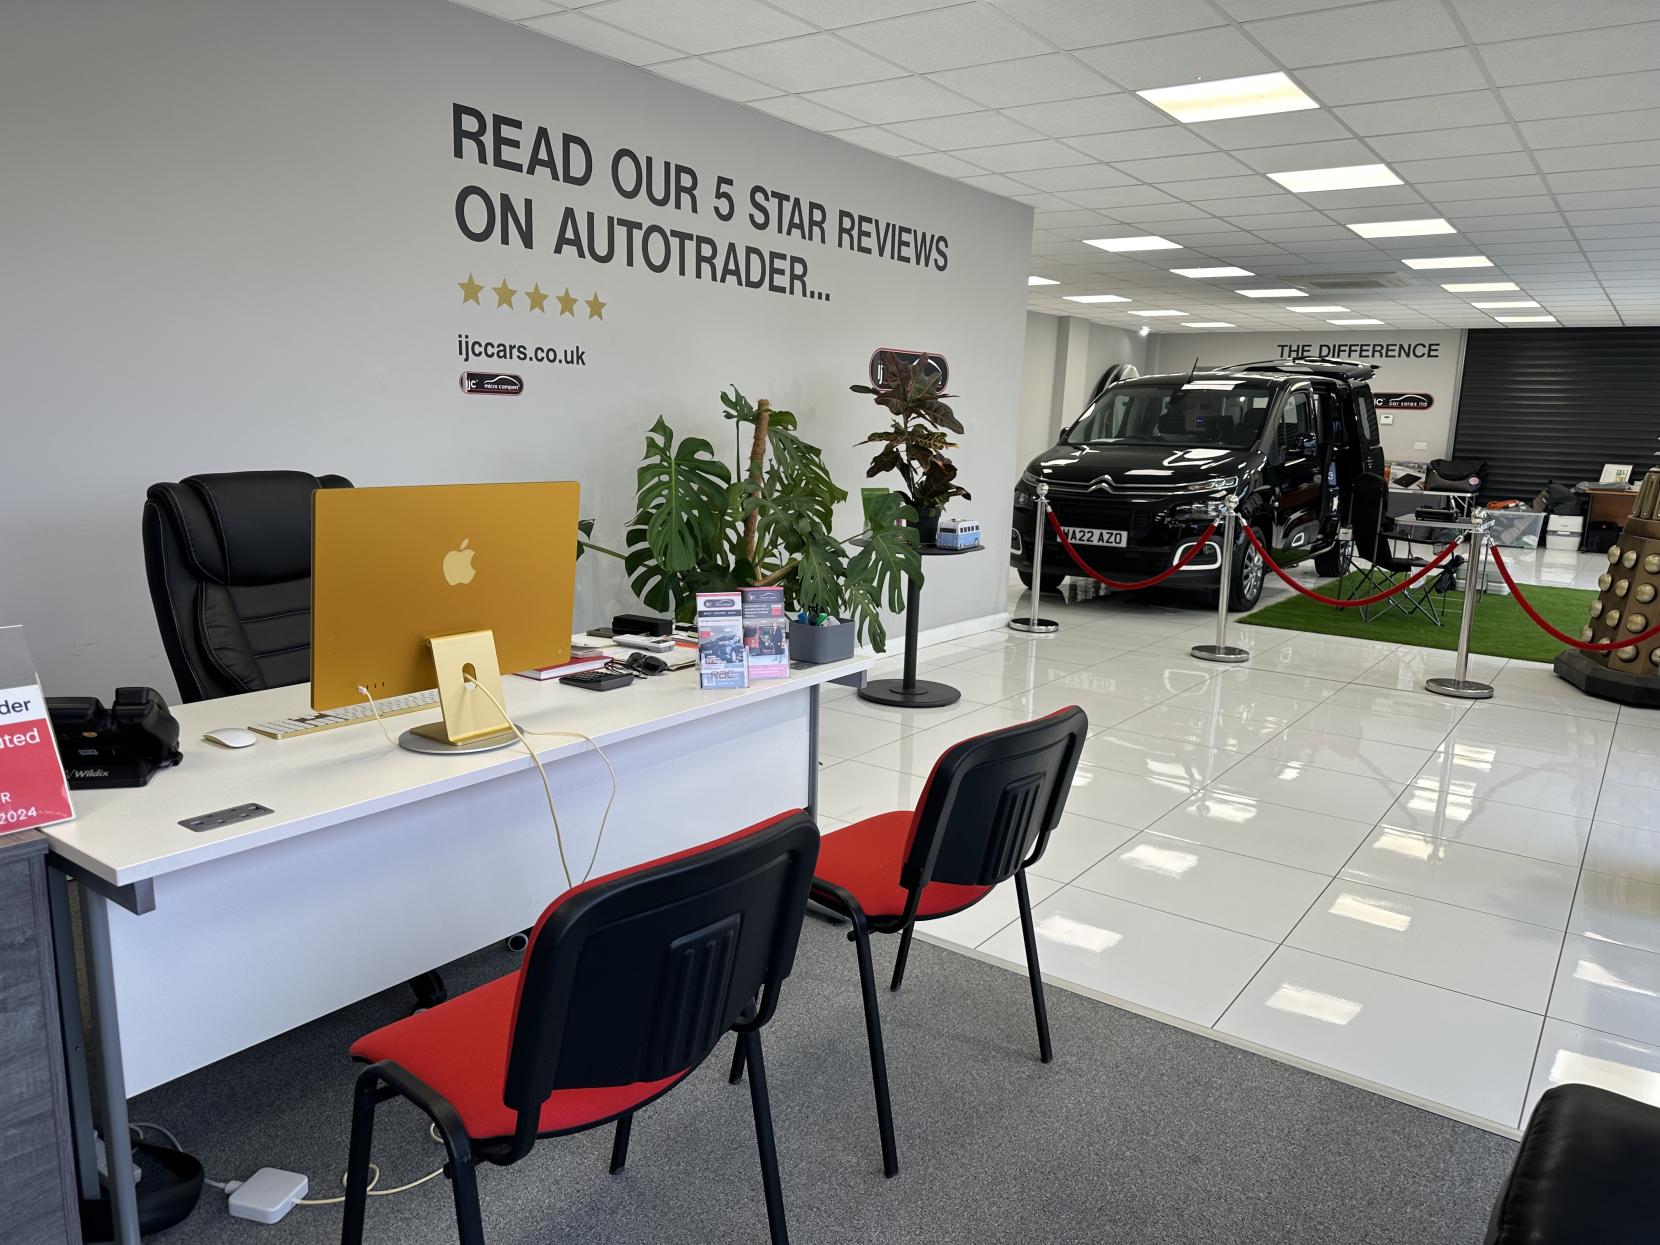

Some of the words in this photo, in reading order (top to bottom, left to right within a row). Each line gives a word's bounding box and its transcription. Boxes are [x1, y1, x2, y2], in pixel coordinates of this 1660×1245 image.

[453, 102, 593, 187] READ
[611, 148, 699, 215] OUR
[713, 175, 735, 222] 5
[748, 185, 828, 244] STAR
[837, 209, 949, 272] REVIEWS
[455, 185, 534, 250] ON
[553, 206, 831, 301] AUTOTRADER...
[458, 334, 586, 366] ijccars.co.uk
[1277, 344, 1312, 358] THE
[1318, 343, 1440, 359] DIFFERENCE
[75, 769, 110, 778] Wildix
[0, 806, 38, 825] 2024
